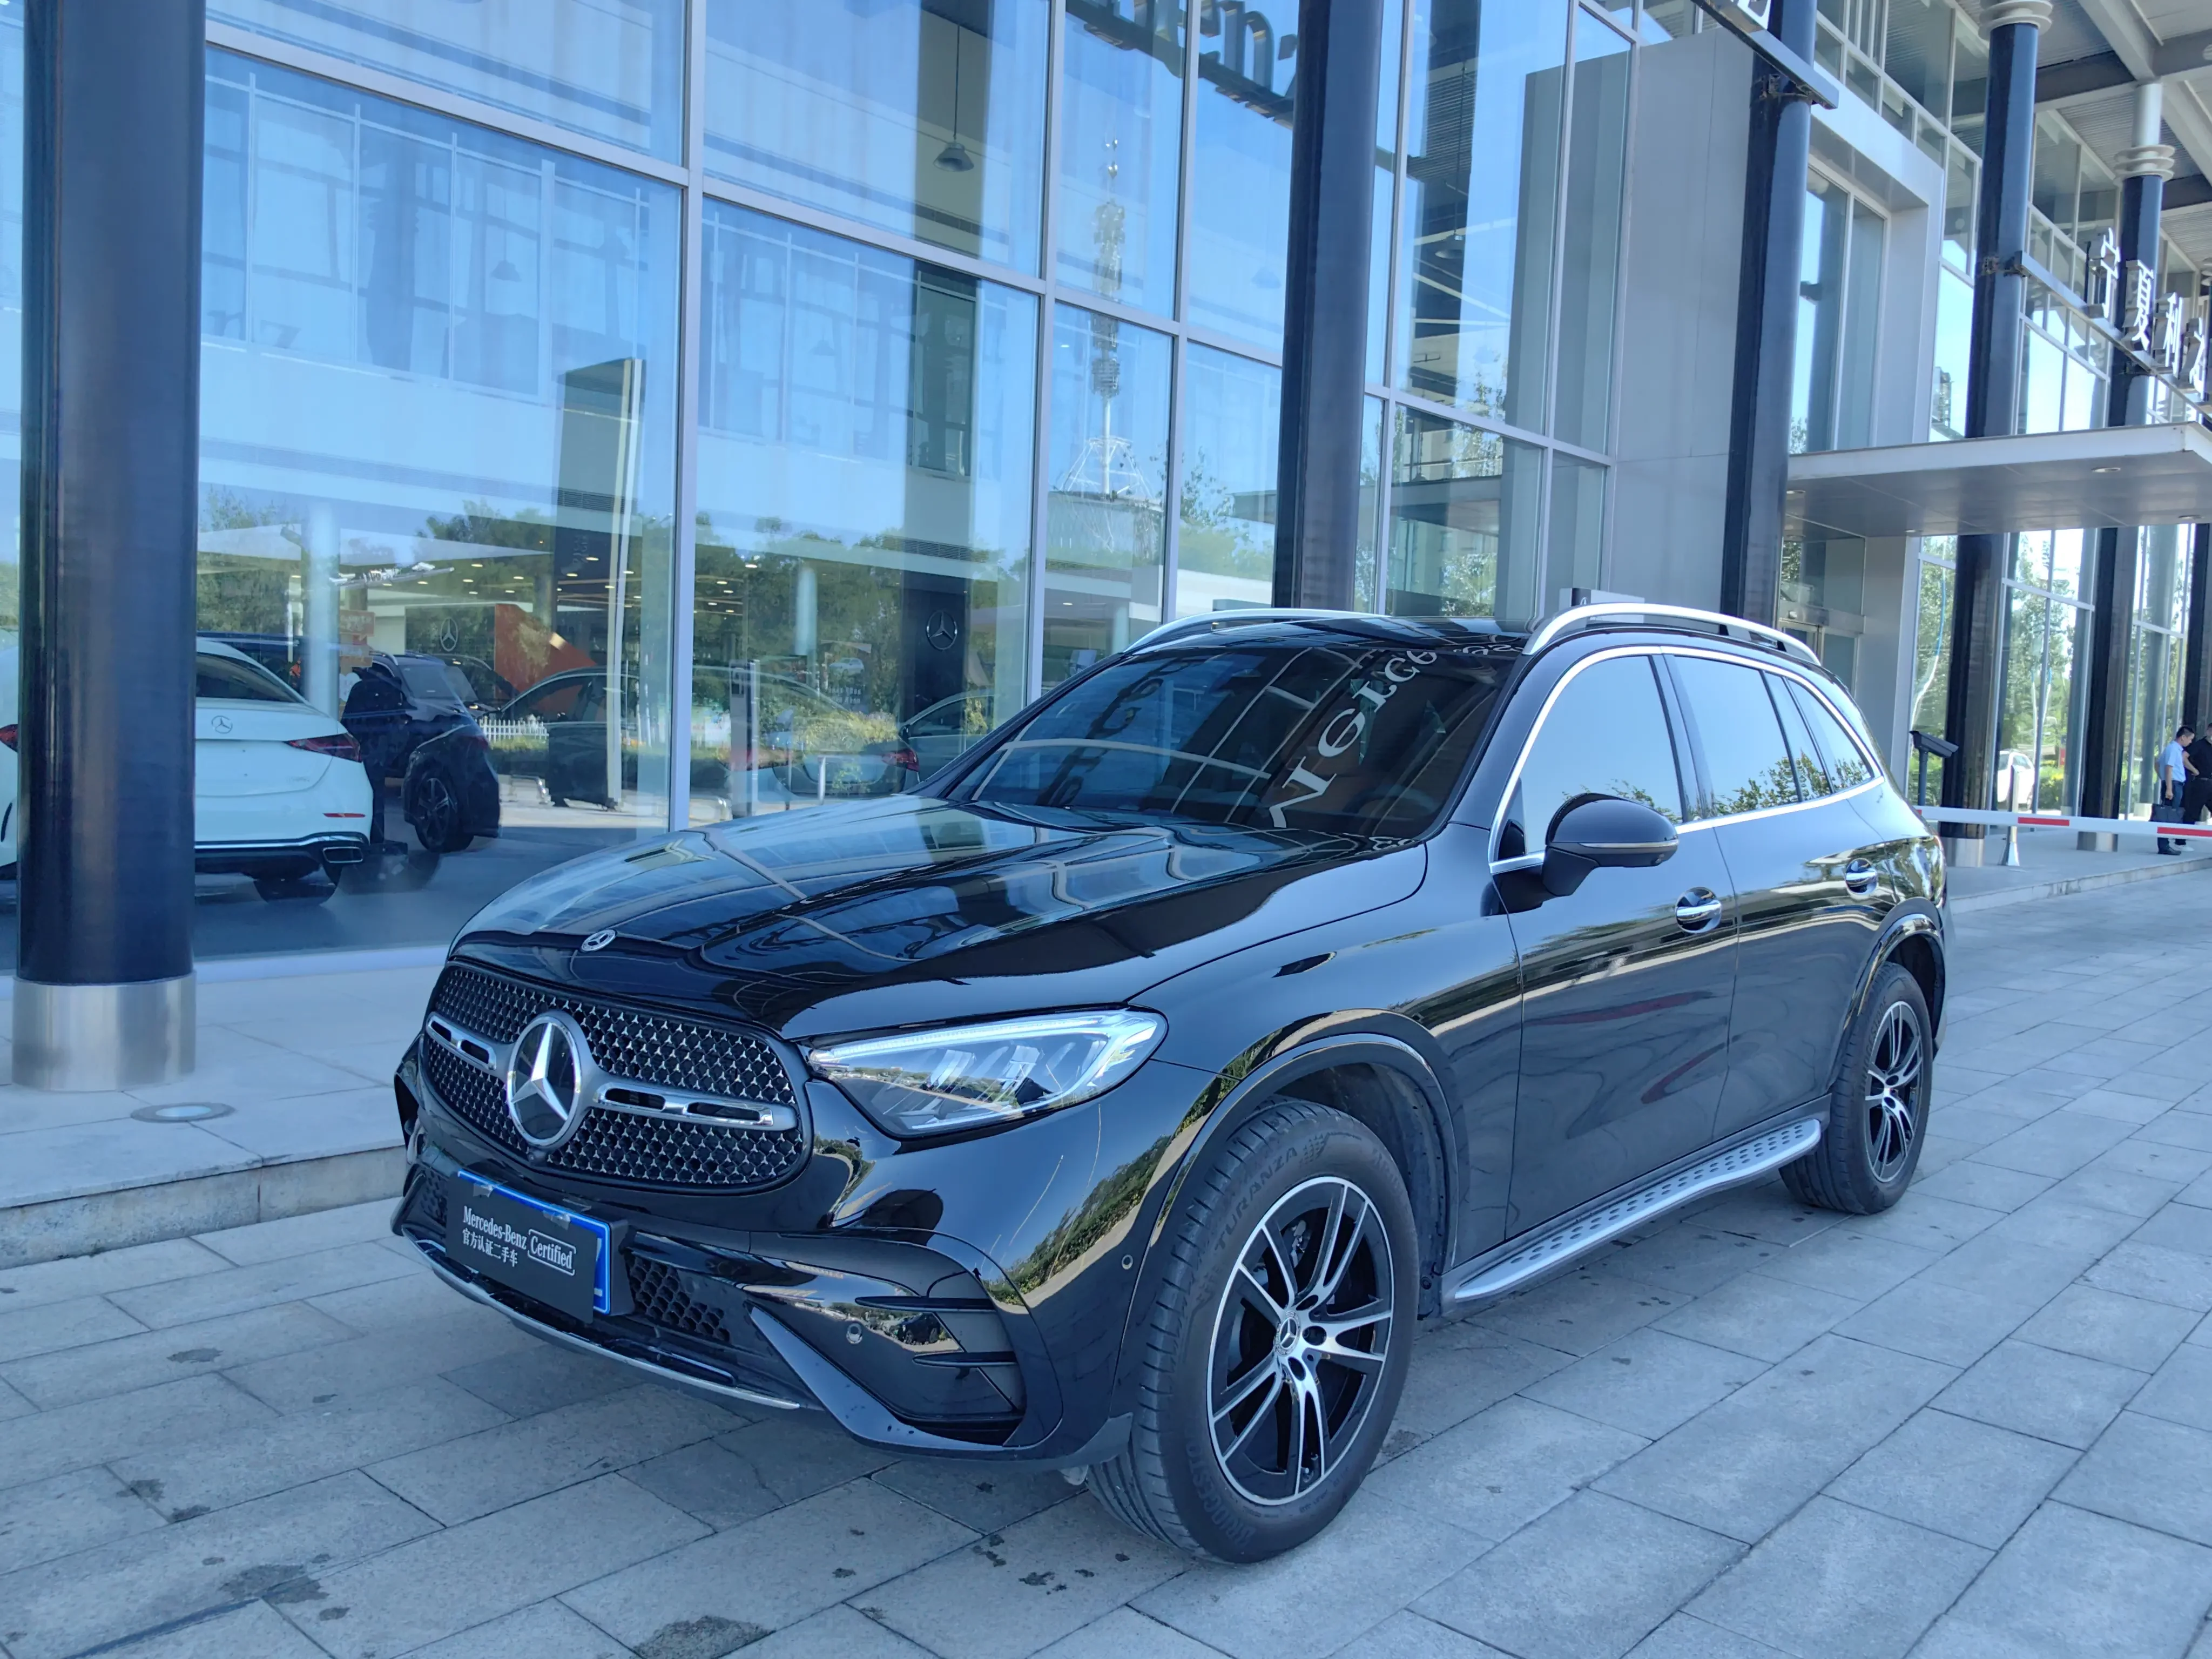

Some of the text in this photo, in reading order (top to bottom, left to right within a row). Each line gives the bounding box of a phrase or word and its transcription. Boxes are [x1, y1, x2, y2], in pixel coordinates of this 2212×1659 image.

[1215, 1147, 1298, 1251] TURANZA
[462, 1228, 518, 1267] 官方认证二手车
[463, 1205, 527, 1250] Mercedes-Benz
[530, 1236, 572, 1270] Certified
